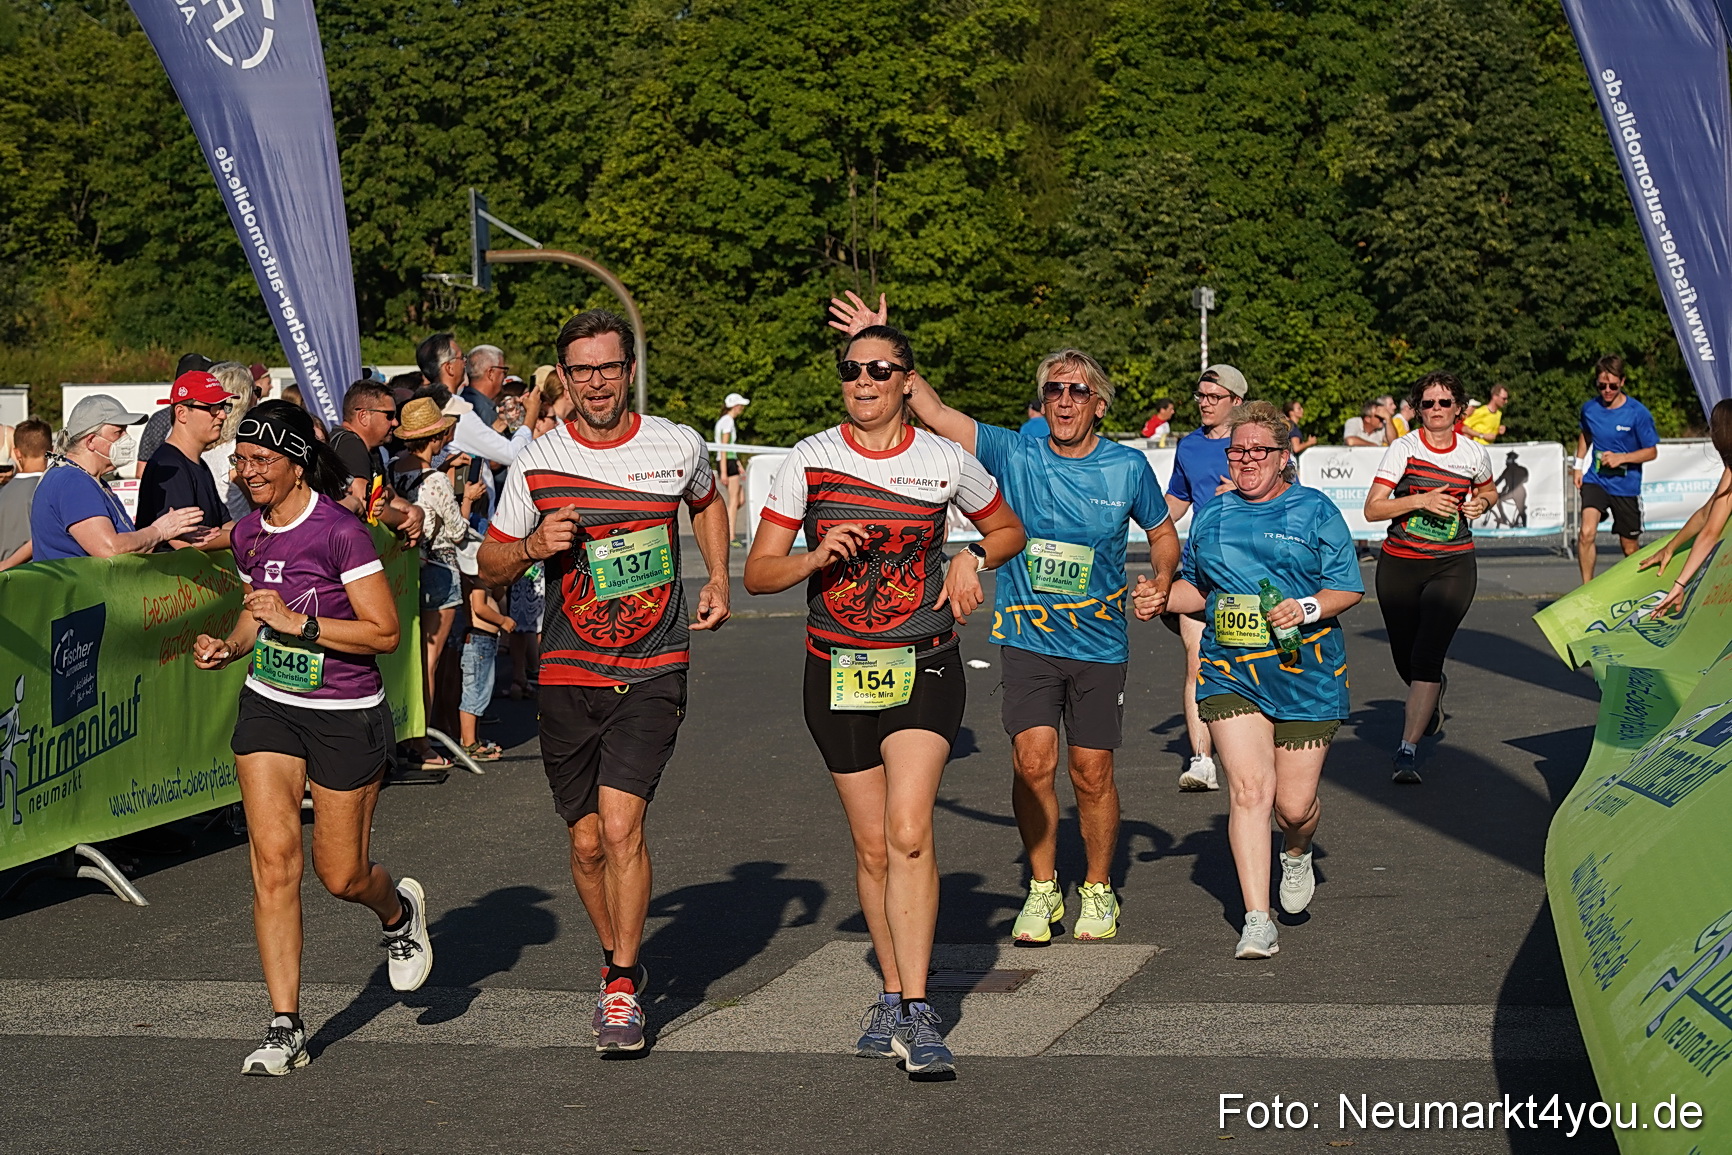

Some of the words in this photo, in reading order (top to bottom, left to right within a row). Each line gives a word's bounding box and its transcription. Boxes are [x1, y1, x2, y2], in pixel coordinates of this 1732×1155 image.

[628, 469, 676, 482] NEUMARKT
[890, 476, 939, 487] NEUMARKT
[1321, 467, 1354, 479] NOW
[1100, 499, 1126, 507] PLAST
[613, 550, 652, 577] 137
[660, 548, 671, 575] 2022
[1034, 556, 1080, 579] 1910
[596, 567, 607, 588] RUN
[608, 578, 630, 588] Jäger
[631, 569, 663, 582] Christian
[1052, 577, 1072, 585] Martin
[1078, 566, 1089, 589] 2022
[143, 575, 197, 632] Gesunde
[1220, 611, 1259, 629] 1905
[1235, 630, 1260, 638] Theresa
[62, 641, 94, 669] Fischer
[263, 646, 309, 674] 1548
[277, 670, 309, 683] Christine
[309, 658, 319, 686] 2022
[853, 668, 896, 690] 154
[836, 671, 844, 701] WALK
[853, 690, 877, 698] Cosic
[901, 671, 911, 697] 2022
[28, 674, 141, 787] firmenlauf
[28, 769, 82, 814] neumarkt
[1662, 1015, 1732, 1078] neumarkt
